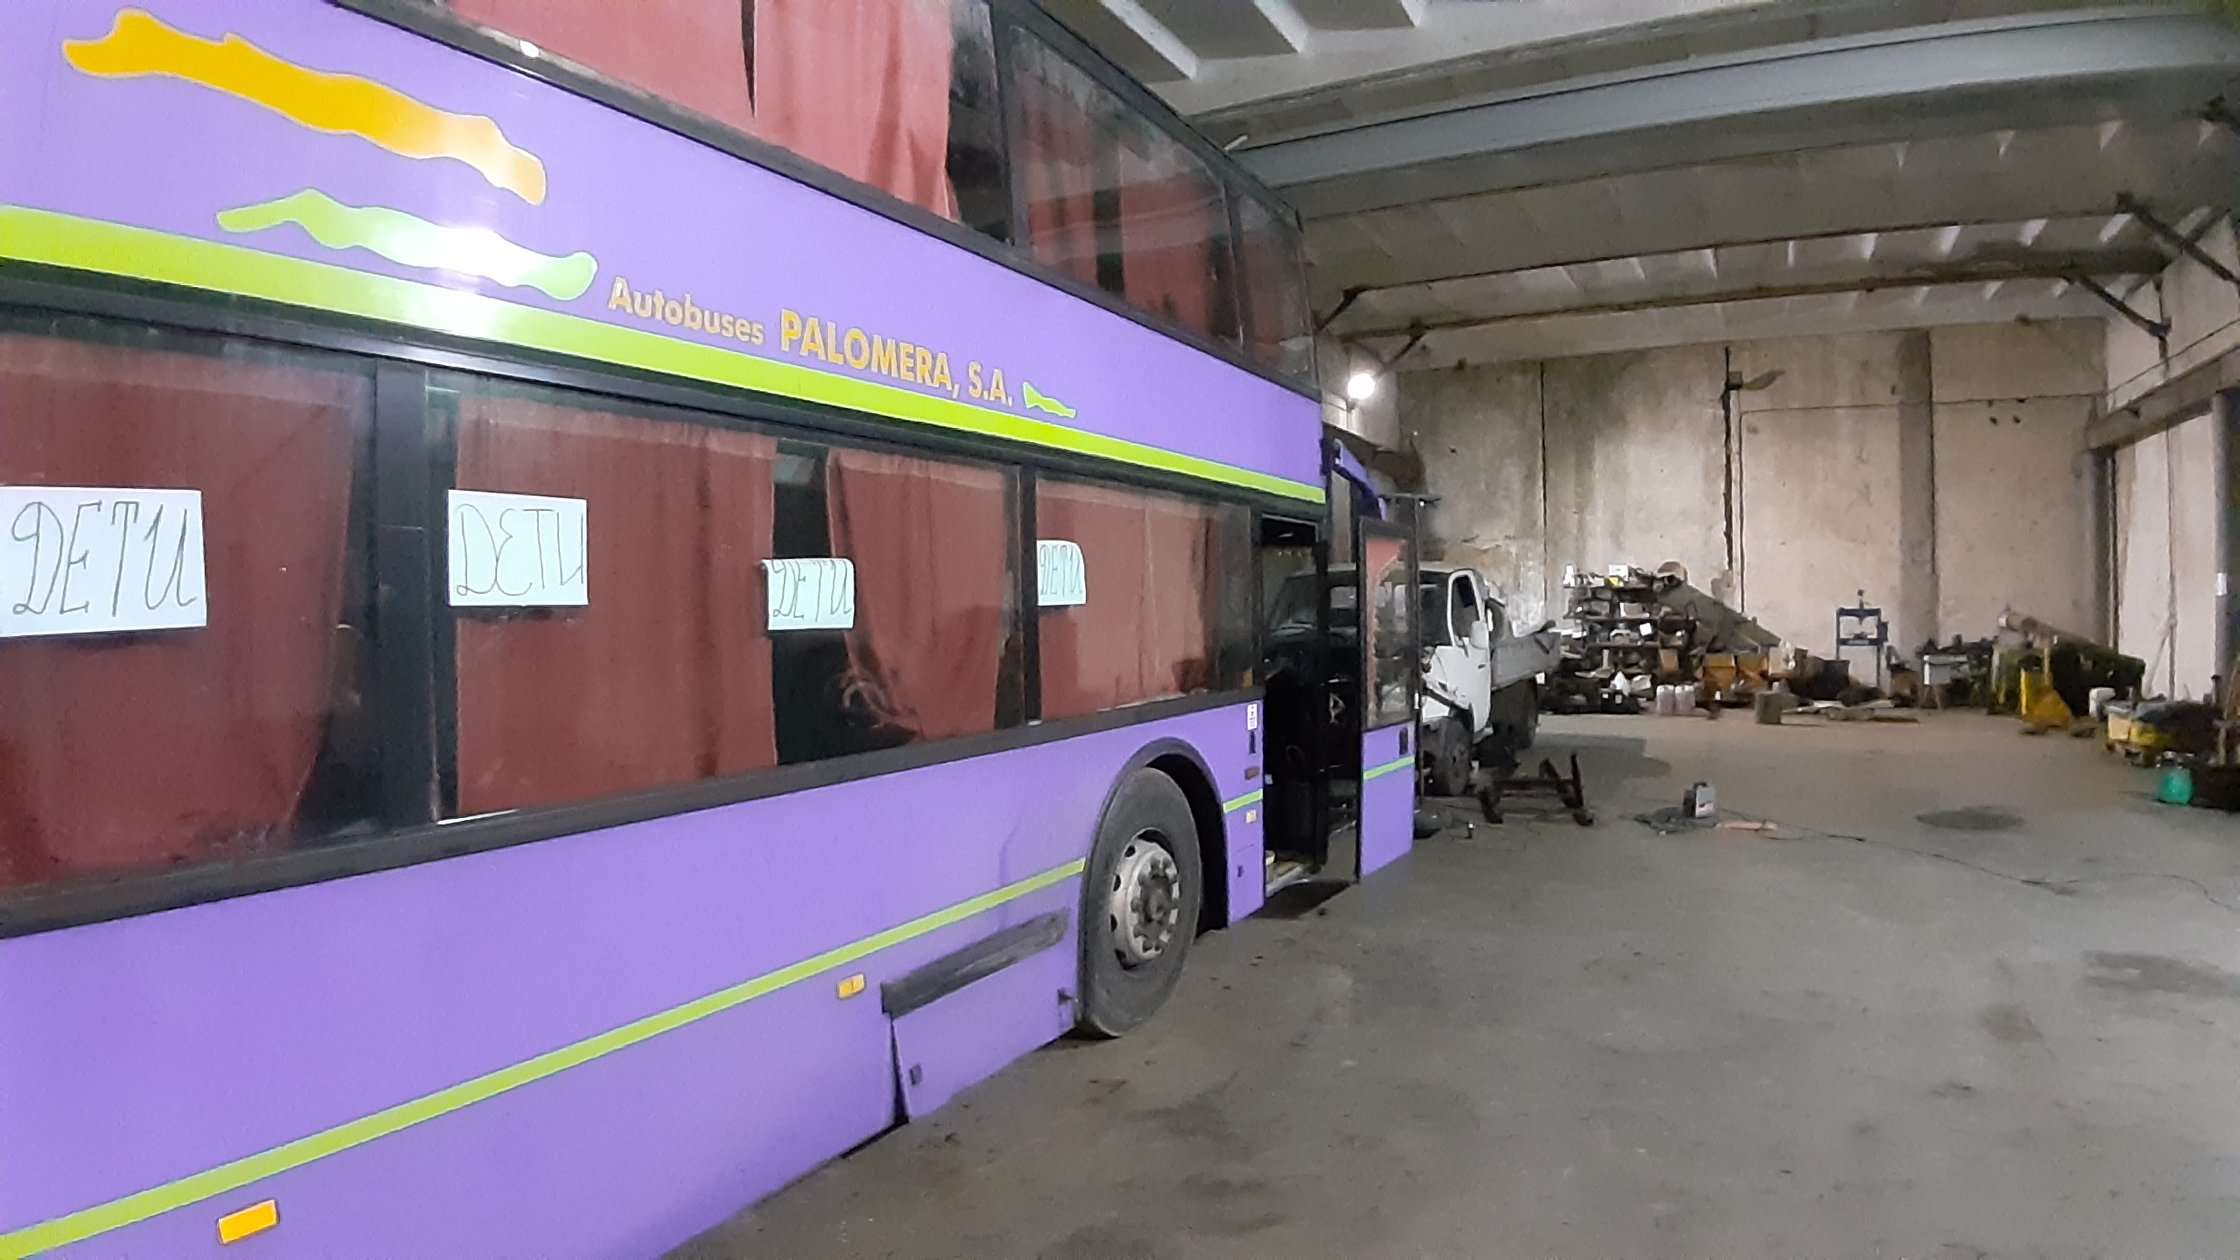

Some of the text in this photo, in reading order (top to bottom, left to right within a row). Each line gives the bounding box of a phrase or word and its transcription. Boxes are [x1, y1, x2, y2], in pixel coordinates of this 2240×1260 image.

[609, 276, 1014, 405] Autobuses PALOMERA, S.A.
